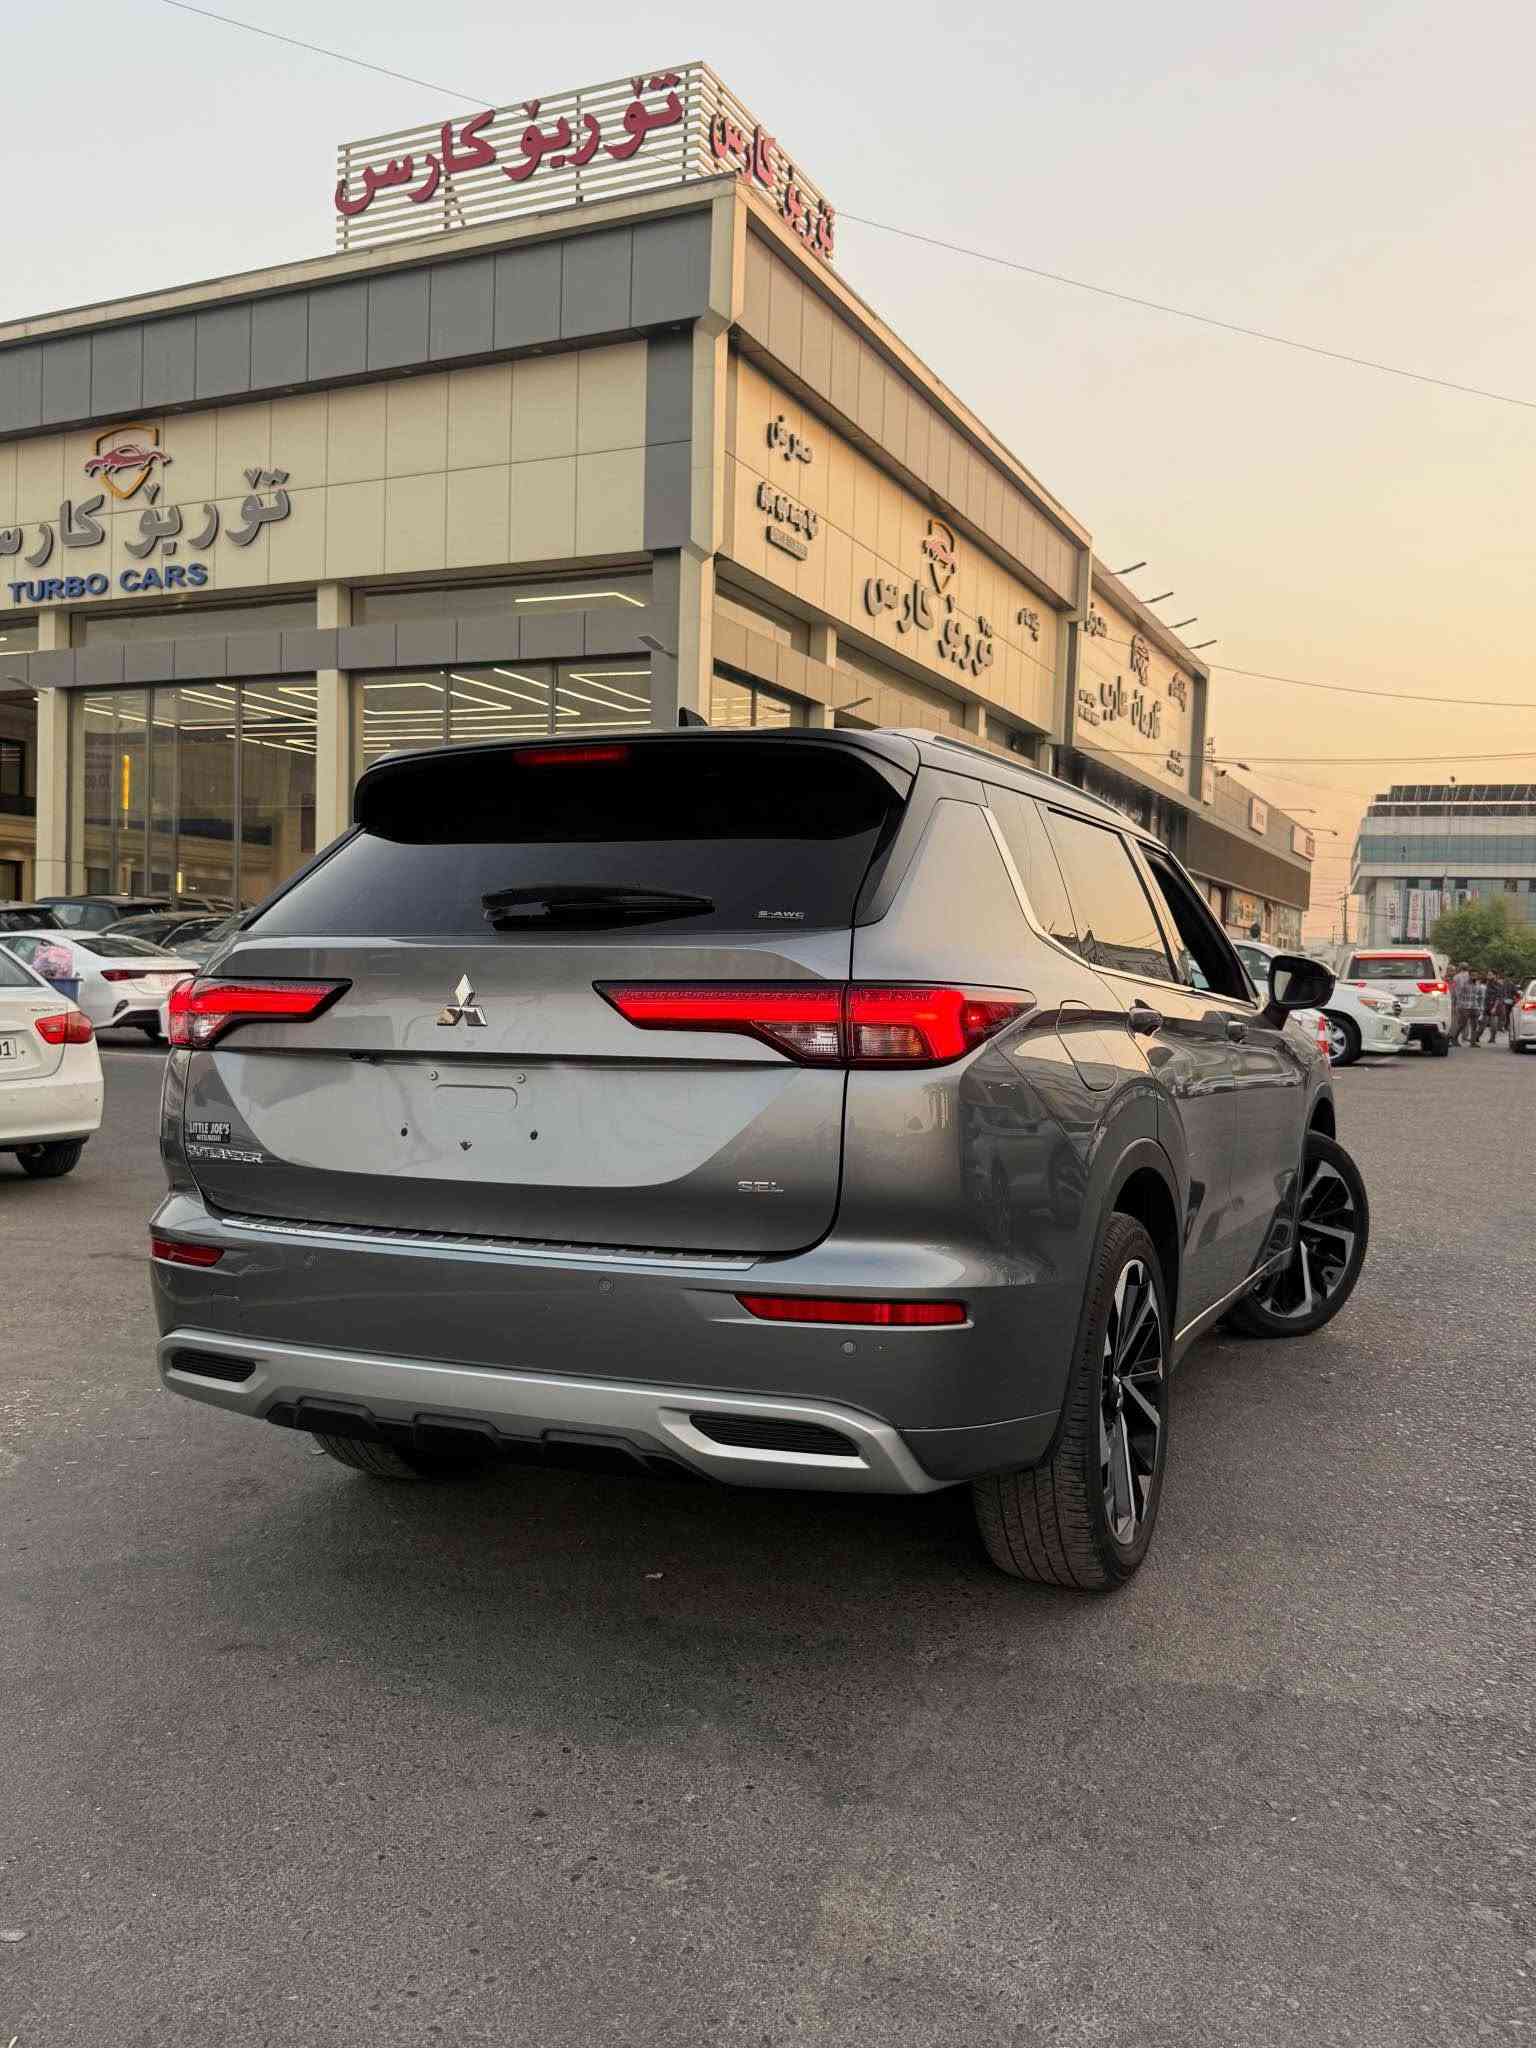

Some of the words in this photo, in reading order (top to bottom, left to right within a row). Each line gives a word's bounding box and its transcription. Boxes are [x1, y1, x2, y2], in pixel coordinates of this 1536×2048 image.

[8, 572, 109, 604] TURBO
[119, 563, 209, 593] CARS
[189, 1122, 209, 1134] LITTLE
[210, 1122, 231, 1135] JOE'S
[737, 1181, 785, 1193] SEL
